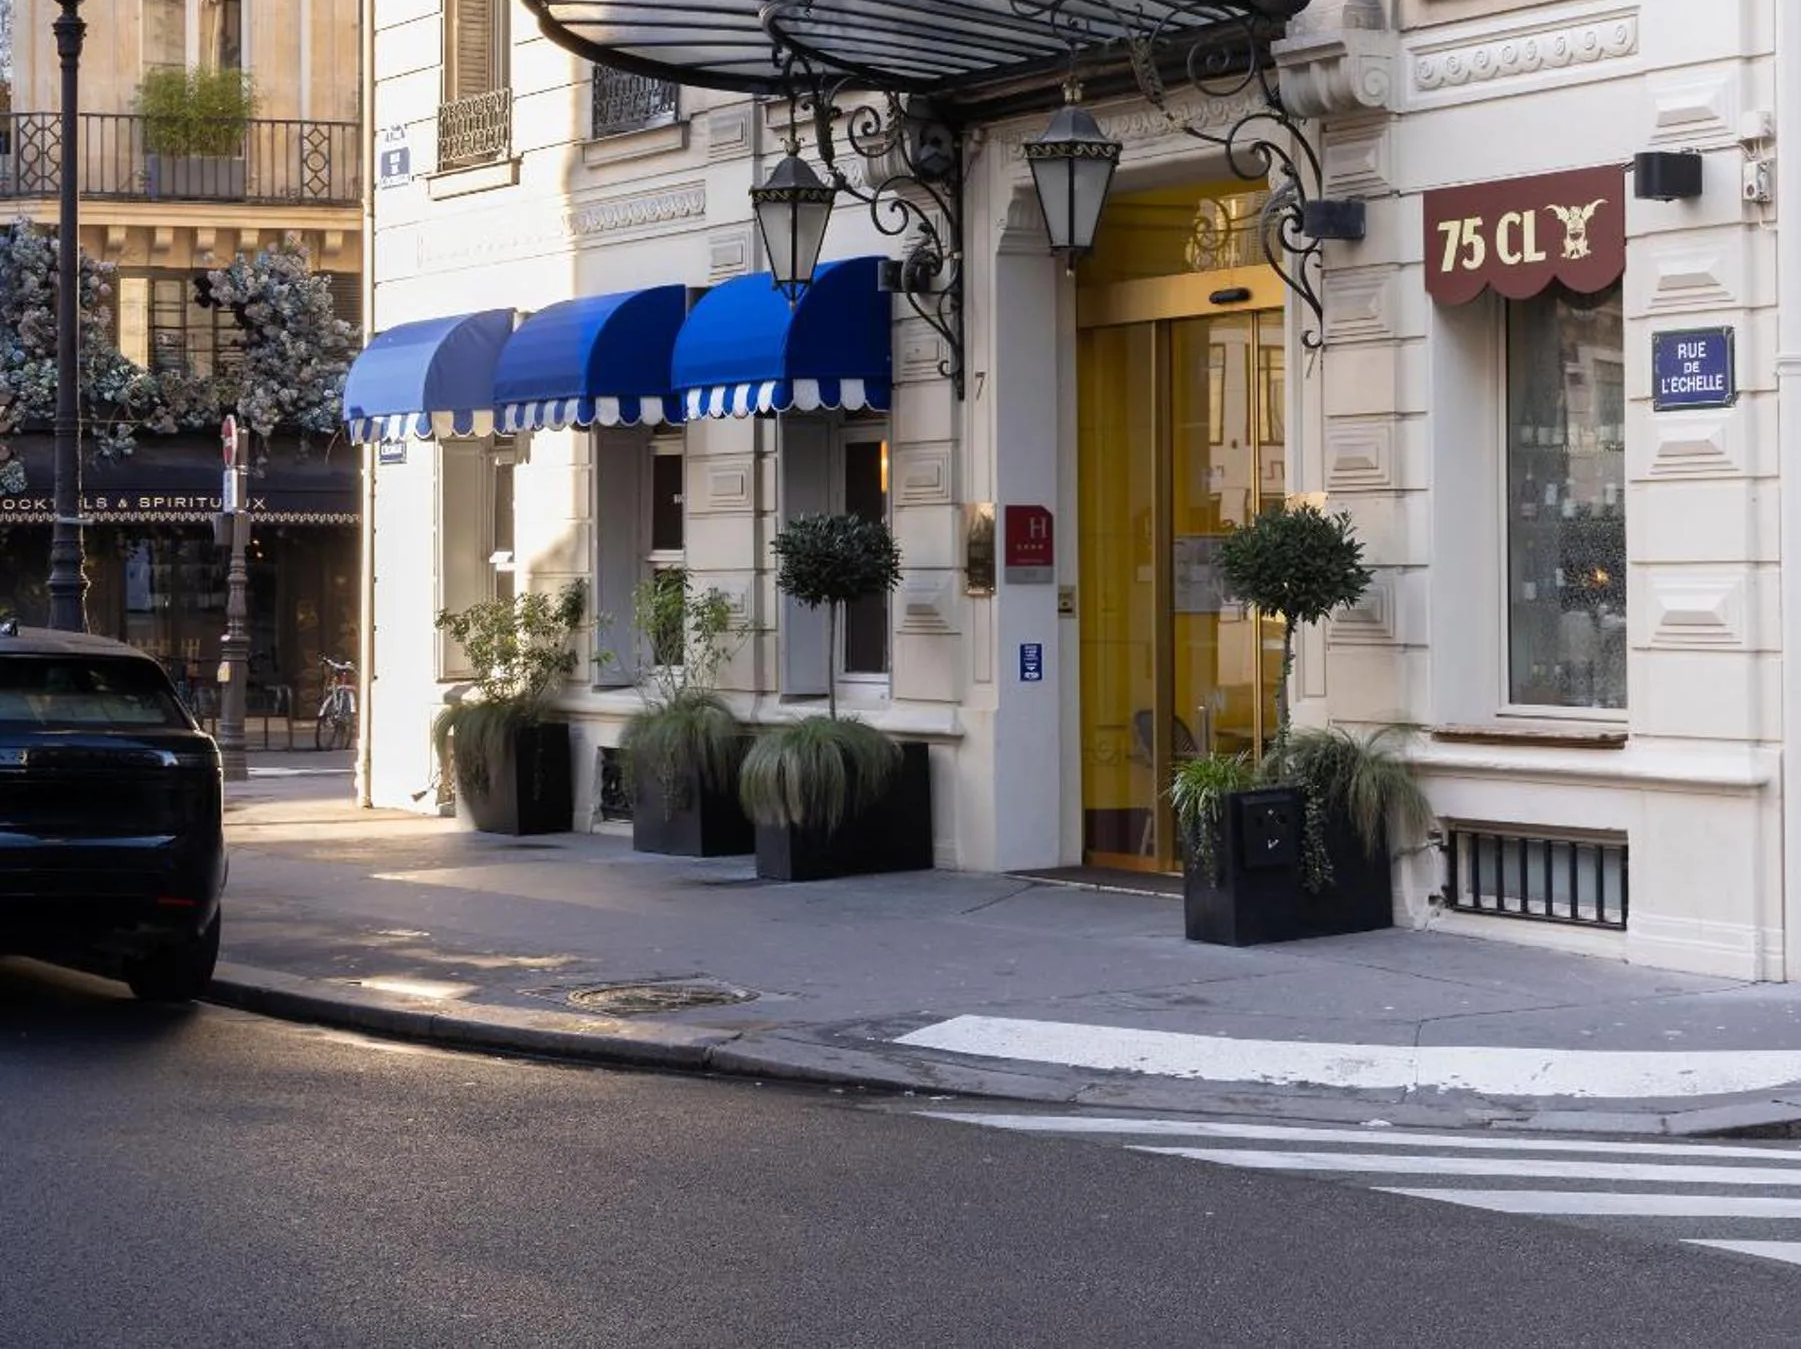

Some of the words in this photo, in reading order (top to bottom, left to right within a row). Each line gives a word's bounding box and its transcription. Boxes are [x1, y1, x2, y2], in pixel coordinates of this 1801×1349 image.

[1437, 216, 1486, 272] 75
[1496, 209, 1547, 265] CL
[1678, 341, 1707, 359] RUE
[1683, 361, 1700, 374] DE
[118, 498, 128, 509] &
[139, 497, 266, 510] SPIRITUX
[1029, 516, 1048, 539] H
